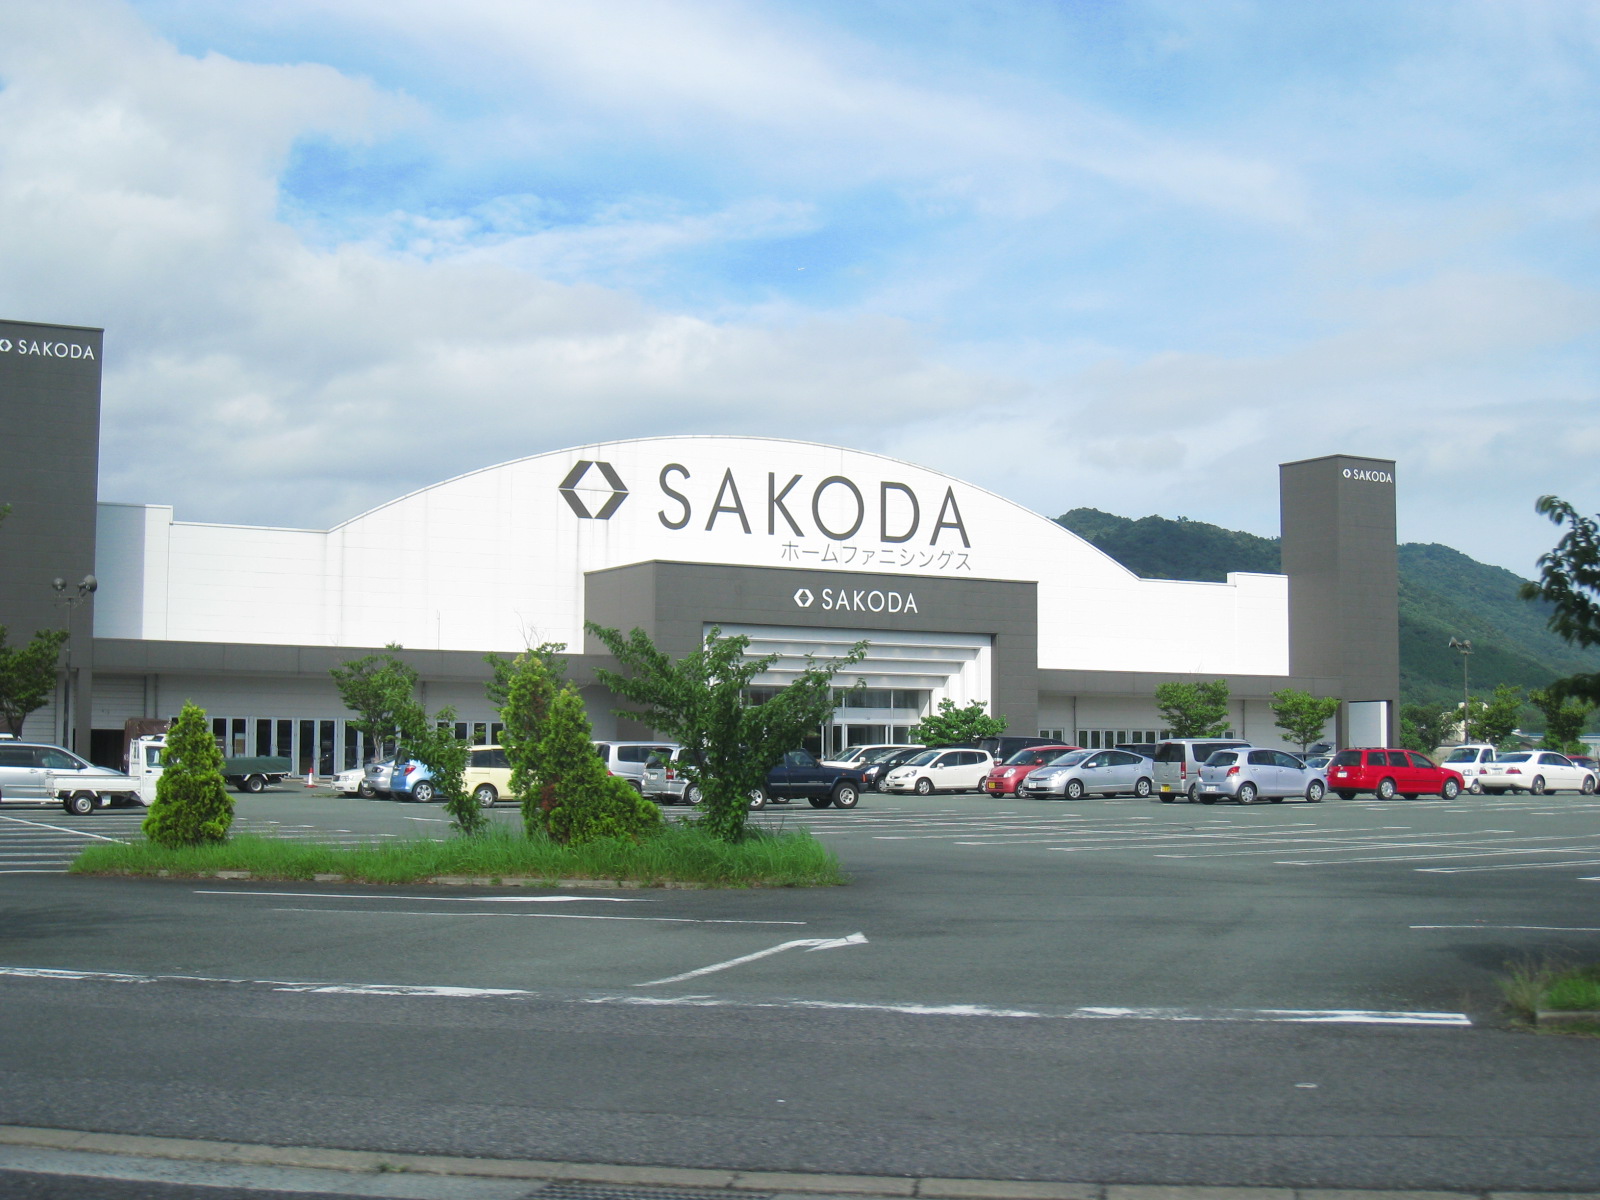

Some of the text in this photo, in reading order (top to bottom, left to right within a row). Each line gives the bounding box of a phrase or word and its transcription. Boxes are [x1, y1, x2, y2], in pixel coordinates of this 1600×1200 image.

[18, 339, 95, 361] SAKODA
[1353, 468, 1393, 484] SAKODA
[658, 463, 971, 549] SAKODA
[781, 541, 971, 571] ホームファニシングス
[821, 588, 918, 614] SAKODA
